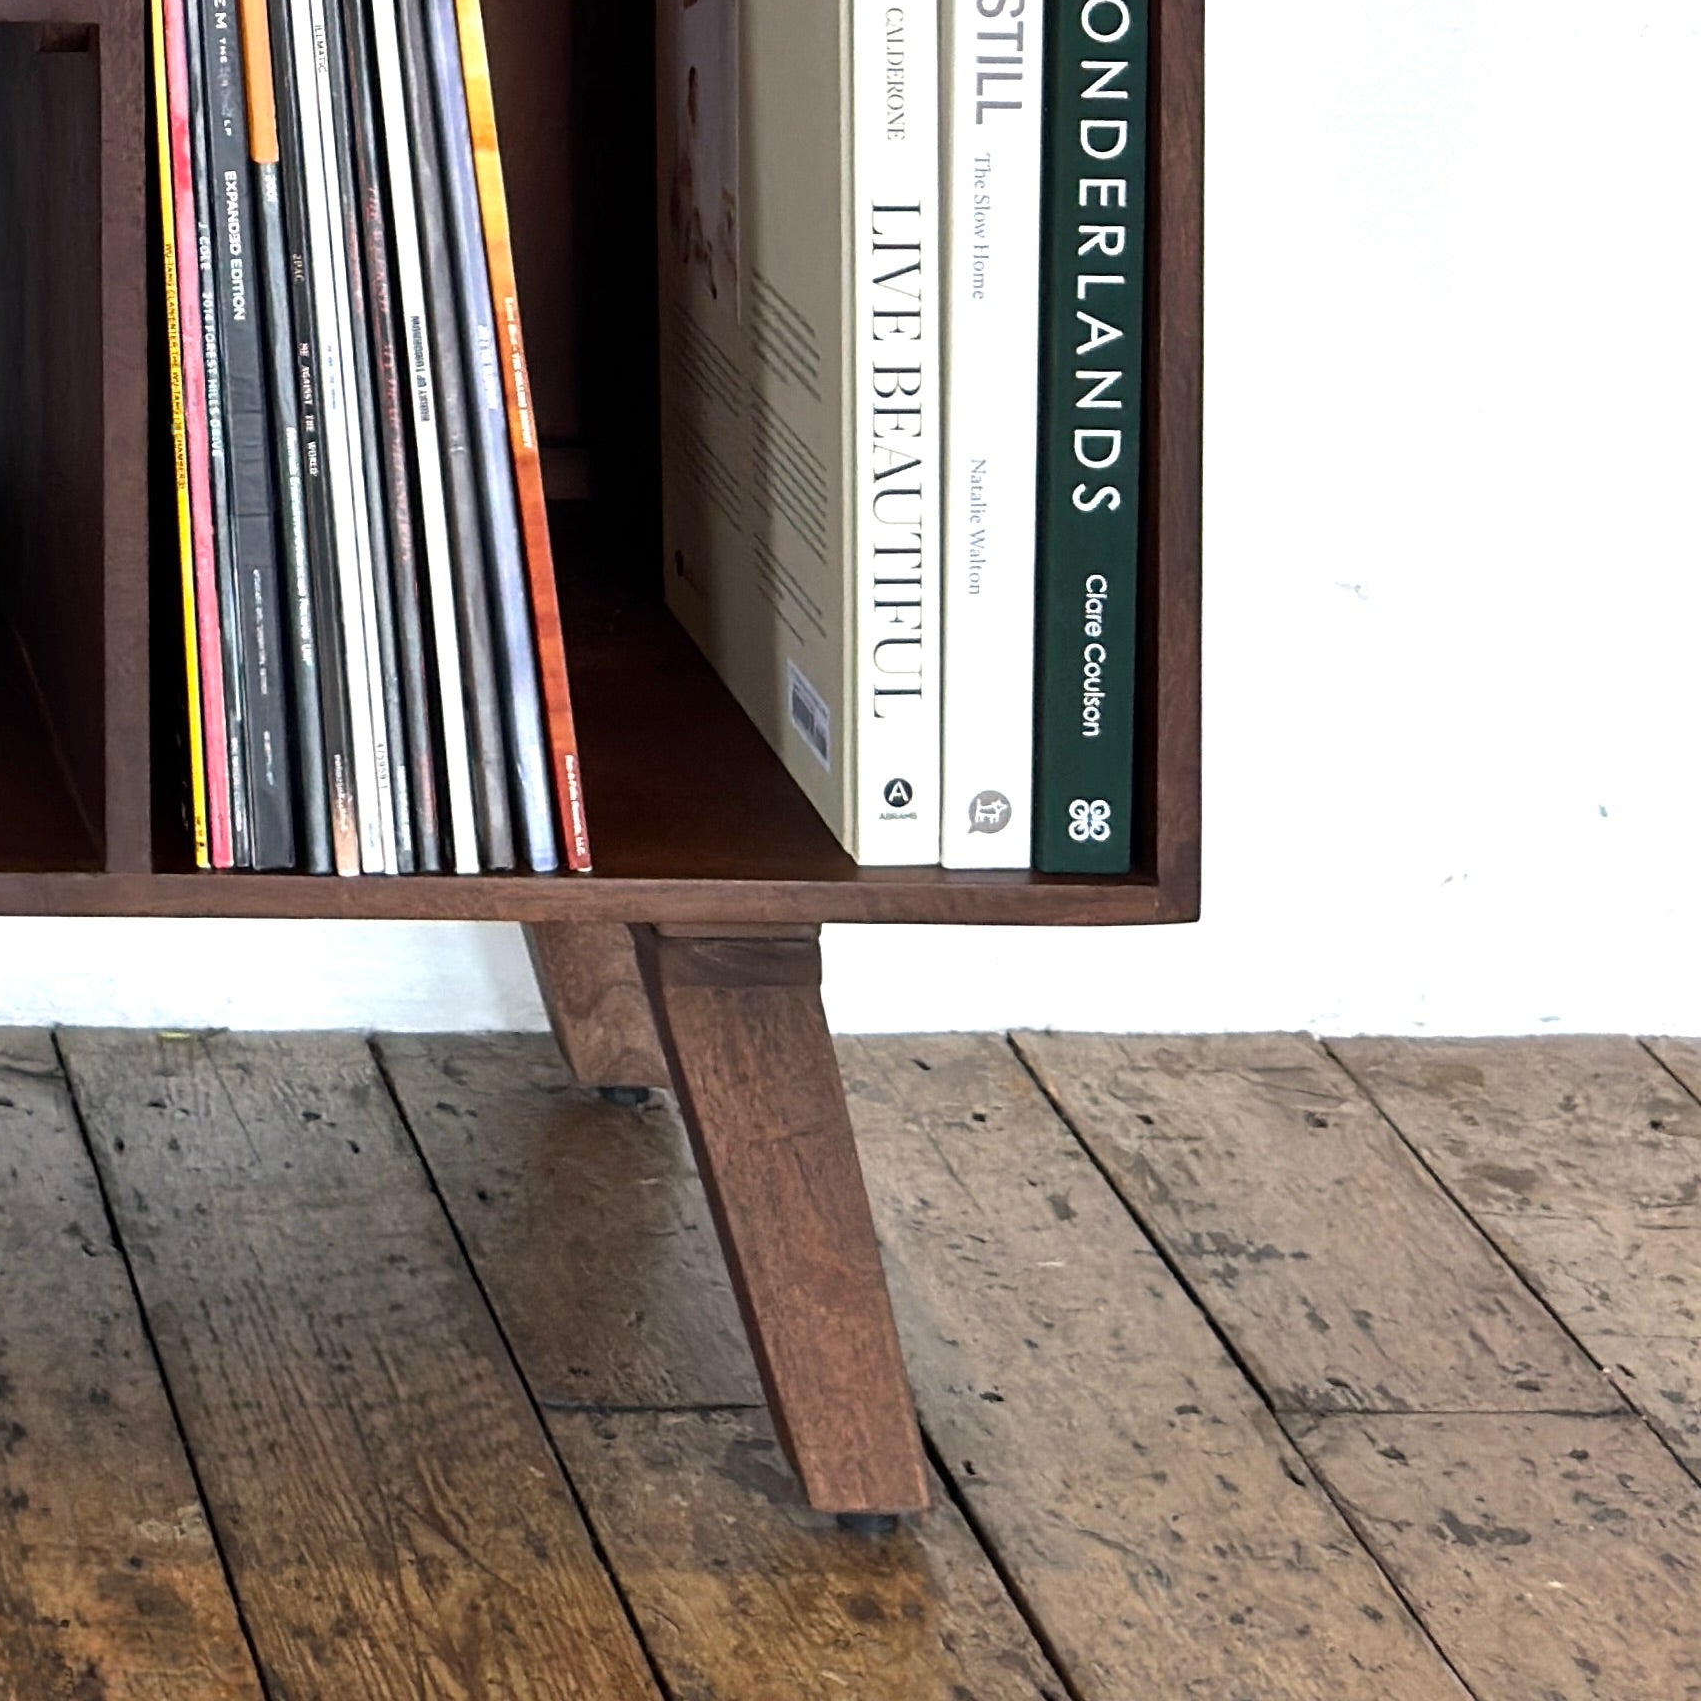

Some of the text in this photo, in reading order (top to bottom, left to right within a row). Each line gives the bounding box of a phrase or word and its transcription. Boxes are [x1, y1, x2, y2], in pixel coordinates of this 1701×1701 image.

[314, 24, 326, 72] ILLMATIC
[885, 6, 907, 141] CALDERONE
[198, 236, 211, 269] COLE
[229, 258, 245, 320] EDITION
[970, 153, 993, 300] The Slow Home
[204, 325, 217, 373] FOREST
[871, 199, 924, 720] LIVE BEAUTIFUL
[967, 458, 987, 596] Natalie Walton
[1079, 573, 1109, 738] Clare Coulson
